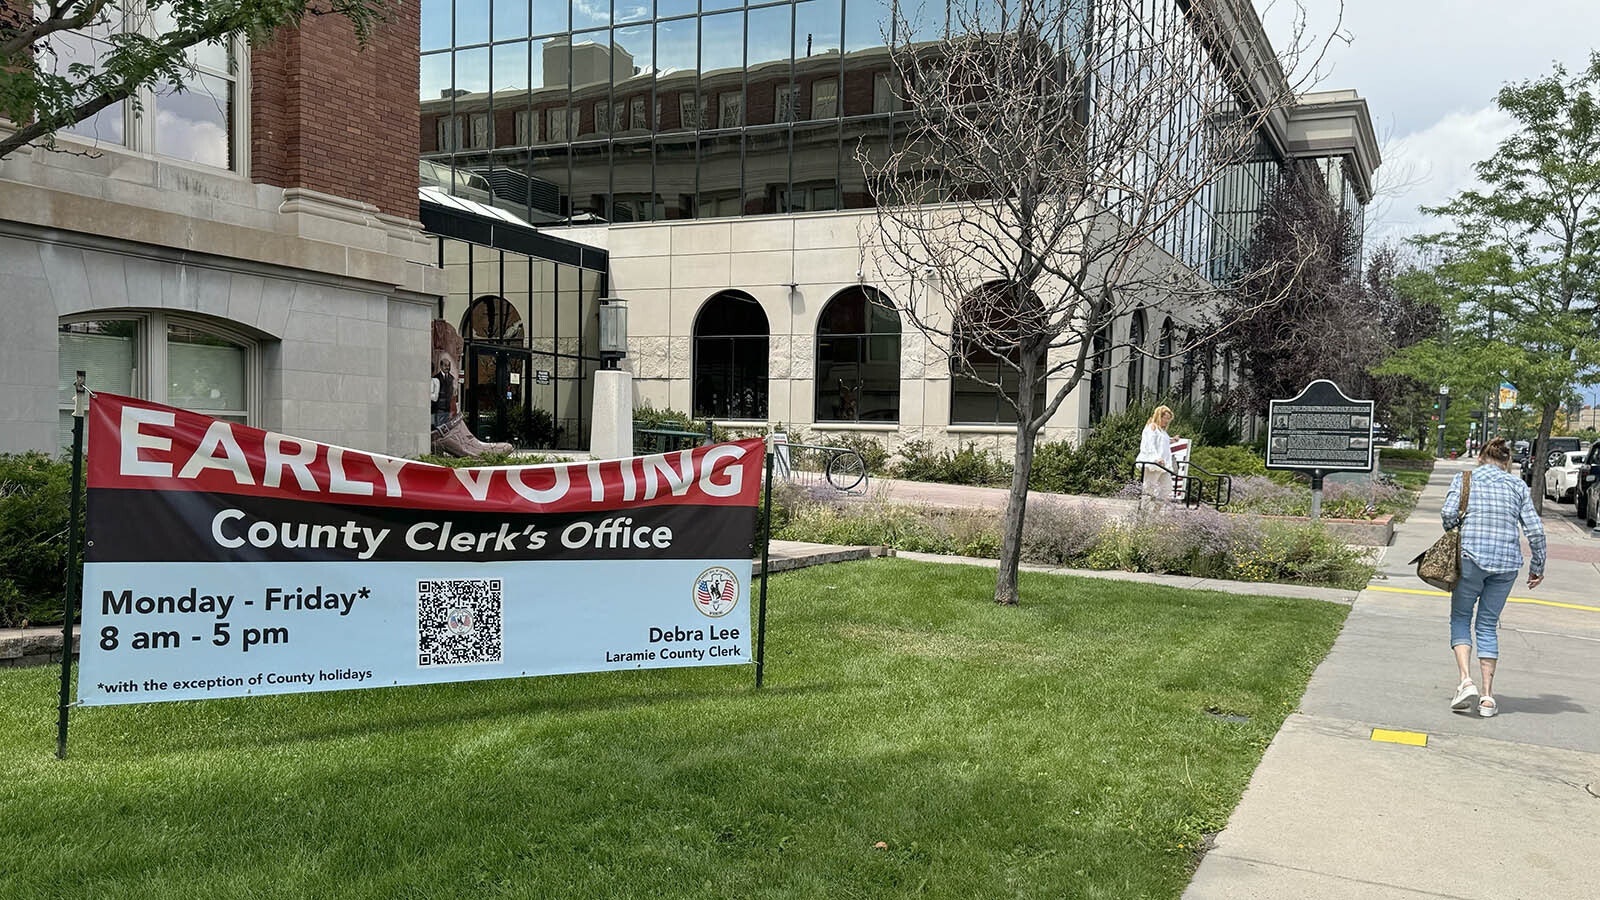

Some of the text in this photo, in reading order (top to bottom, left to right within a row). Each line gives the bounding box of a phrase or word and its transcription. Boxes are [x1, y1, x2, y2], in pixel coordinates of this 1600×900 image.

[120, 405, 406, 497] EARLY
[211, 509, 673, 560] County Clerk's Office
[102, 588, 235, 619] Monday
[100, 626, 119, 651] 8
[131, 630, 180, 650] am
[212, 623, 230, 647] 5
[242, 626, 289, 652] pm
[649, 625, 739, 642] Debra Lee
[606, 645, 741, 662] Laramie County Clerk
[143, 679, 168, 692] the
[172, 676, 244, 691] exception
[248, 672, 264, 687] of
[266, 671, 315, 686] County
[319, 668, 373, 682] holidays
